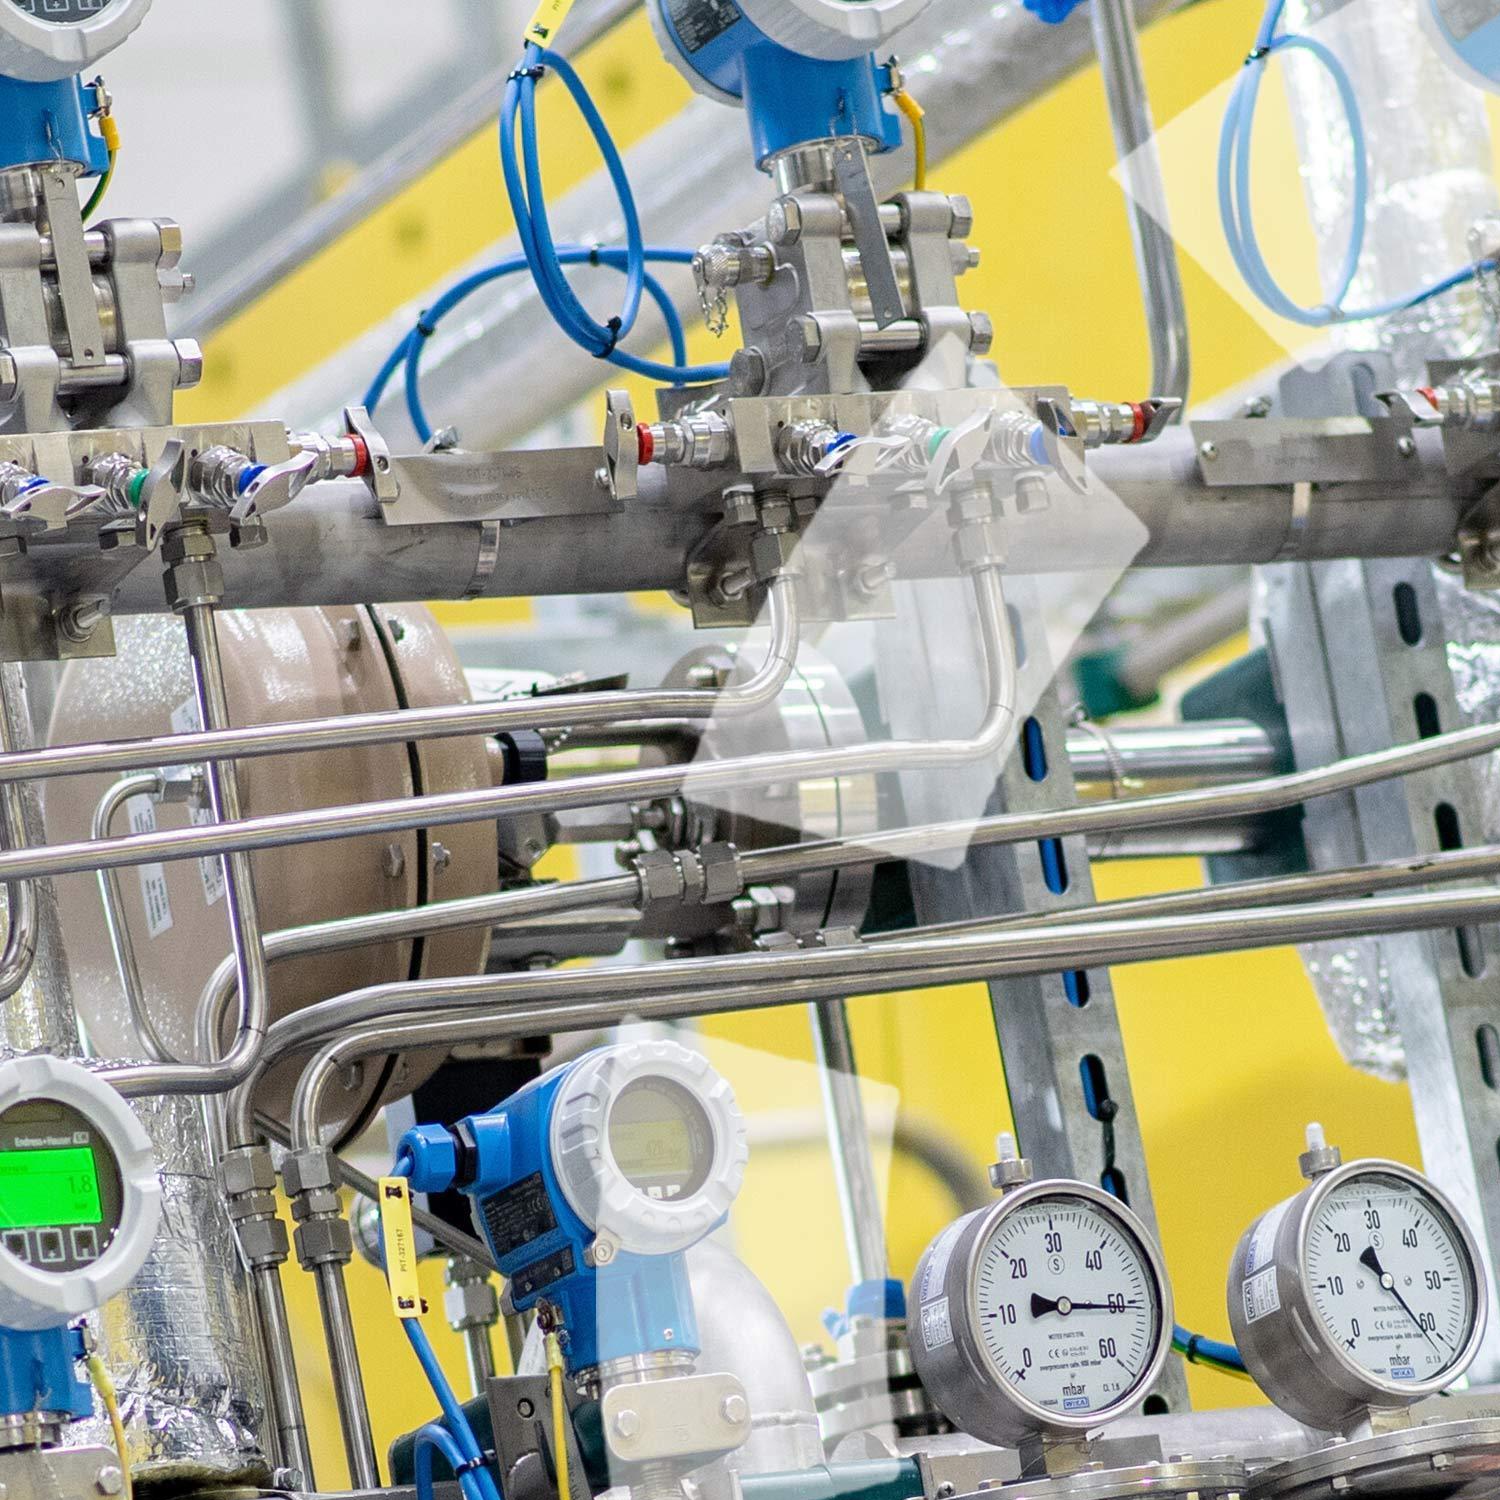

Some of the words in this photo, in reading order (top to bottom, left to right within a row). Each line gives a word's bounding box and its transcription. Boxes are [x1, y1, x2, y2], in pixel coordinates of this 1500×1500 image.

[67, 1173, 92, 1195] 1.8
[1364, 1208, 1381, 1230] 30
[1045, 1231, 1062, 1254] 30
[1334, 1232, 1351, 1253] 20
[1402, 1228, 1418, 1249] 40
[1009, 1258, 1027, 1279] 20
[1085, 1250, 1102, 1271] 40
[1327, 1275, 1344, 1296] 10
[1424, 1270, 1441, 1290] 50
[998, 1303, 1016, 1325] 10
[1107, 1293, 1126, 1315] 50
[1351, 1318, 1360, 1338] 0
[1418, 1311, 1436, 1332] 60
[1023, 1347, 1032, 1369] 0
[1099, 1337, 1116, 1359] 60
[1389, 1352, 1411, 1367] mbar
[1062, 1382, 1086, 1397] mbar
